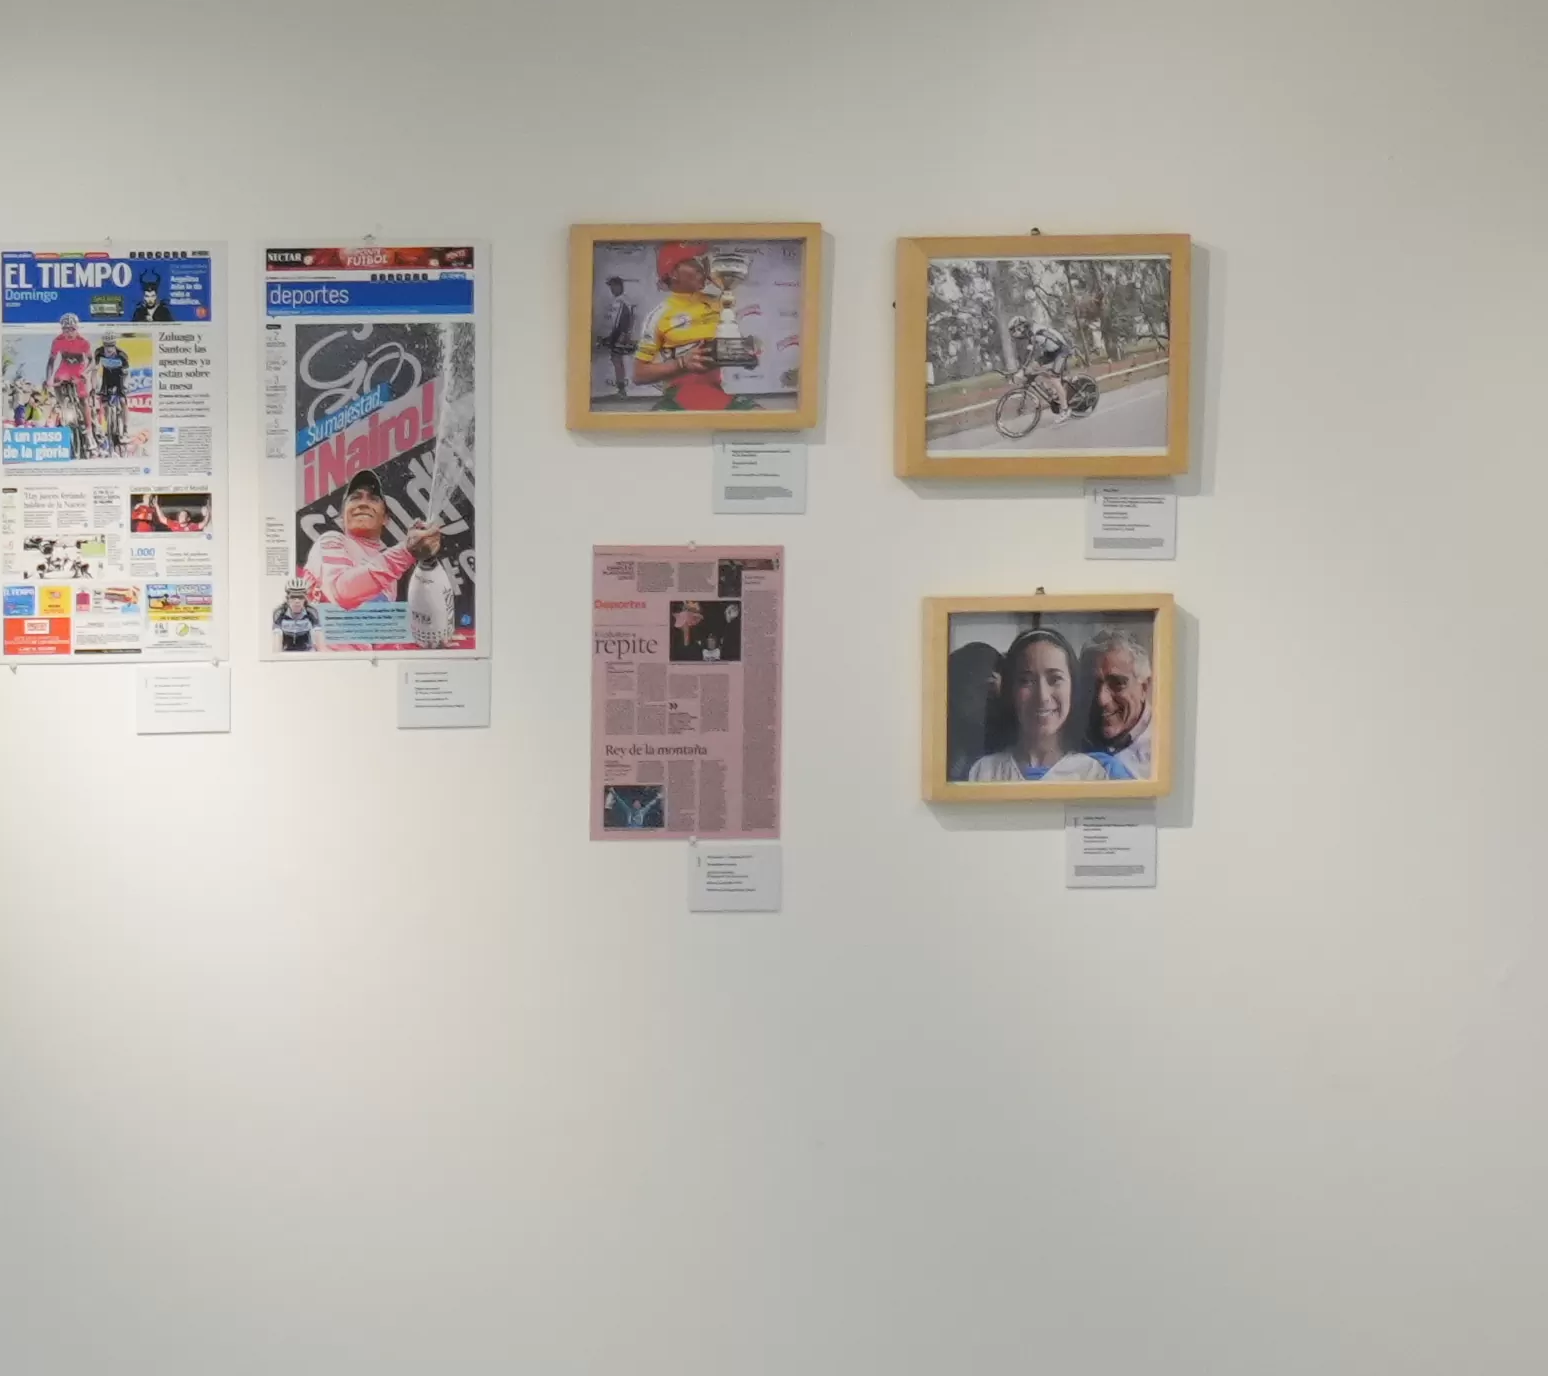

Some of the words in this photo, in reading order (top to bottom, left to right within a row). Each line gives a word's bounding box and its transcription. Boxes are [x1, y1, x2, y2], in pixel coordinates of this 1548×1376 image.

[267, 252, 302, 262] NECTAR
[5, 263, 33, 289] EL
[37, 262, 132, 288] TIEMPO
[5, 290, 58, 302] Domingo
[270, 284, 349, 308] deportes
[158, 333, 196, 343] Zuluaga
[198, 335, 204, 343] y
[194, 344, 207, 353] las
[158, 357, 199, 367] apuestas
[200, 358, 211, 367] ya
[158, 369, 183, 378] están
[184, 369, 210, 378] sobre
[158, 381, 168, 391] la
[169, 383, 193, 391] mesa
[4, 431, 12, 442] A
[15, 433, 31, 442] un
[33, 432, 62, 444] paso
[306, 424, 323, 446] Su
[303, 382, 435, 505] ¡Nairo!
[3, 447, 19, 458] de
[21, 446, 33, 458] la
[35, 446, 70, 461] gloria
[594, 638, 658, 659] repite
[605, 744, 627, 758] Rey
[629, 743, 642, 755] de
[645, 743, 655, 755] la
[657, 743, 707, 755] montaña
